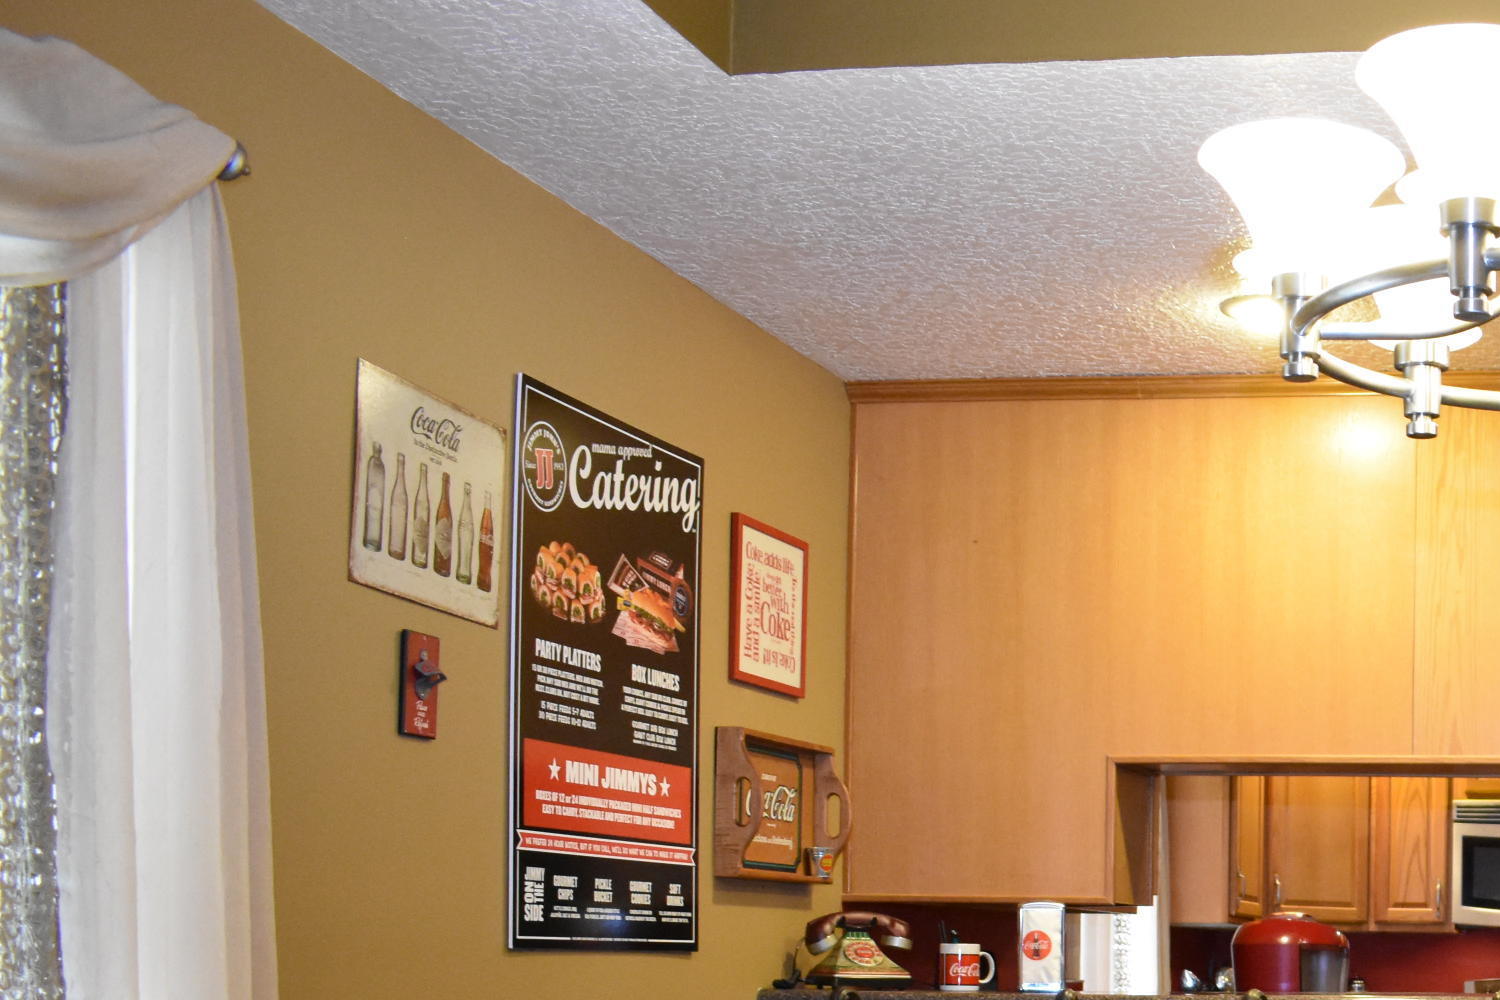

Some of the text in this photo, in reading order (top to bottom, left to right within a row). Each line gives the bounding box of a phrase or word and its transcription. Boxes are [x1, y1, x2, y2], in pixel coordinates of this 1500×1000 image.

[411, 407, 462, 452] Coca-Cola
[592, 443, 652, 460] mama approved
[569, 444, 700, 533] Catering
[746, 541, 763, 563] Coke
[770, 593, 789, 614] with
[761, 601, 791, 641] Coke
[536, 638, 602, 672] PARTY PLATTERS
[632, 664, 680, 692] BOX LUNCHES
[566, 760, 656, 796] MINI JIMMYS
[524, 881, 534, 903] ON
[534, 882, 544, 903] THE
[524, 904, 544, 922] SIDE
